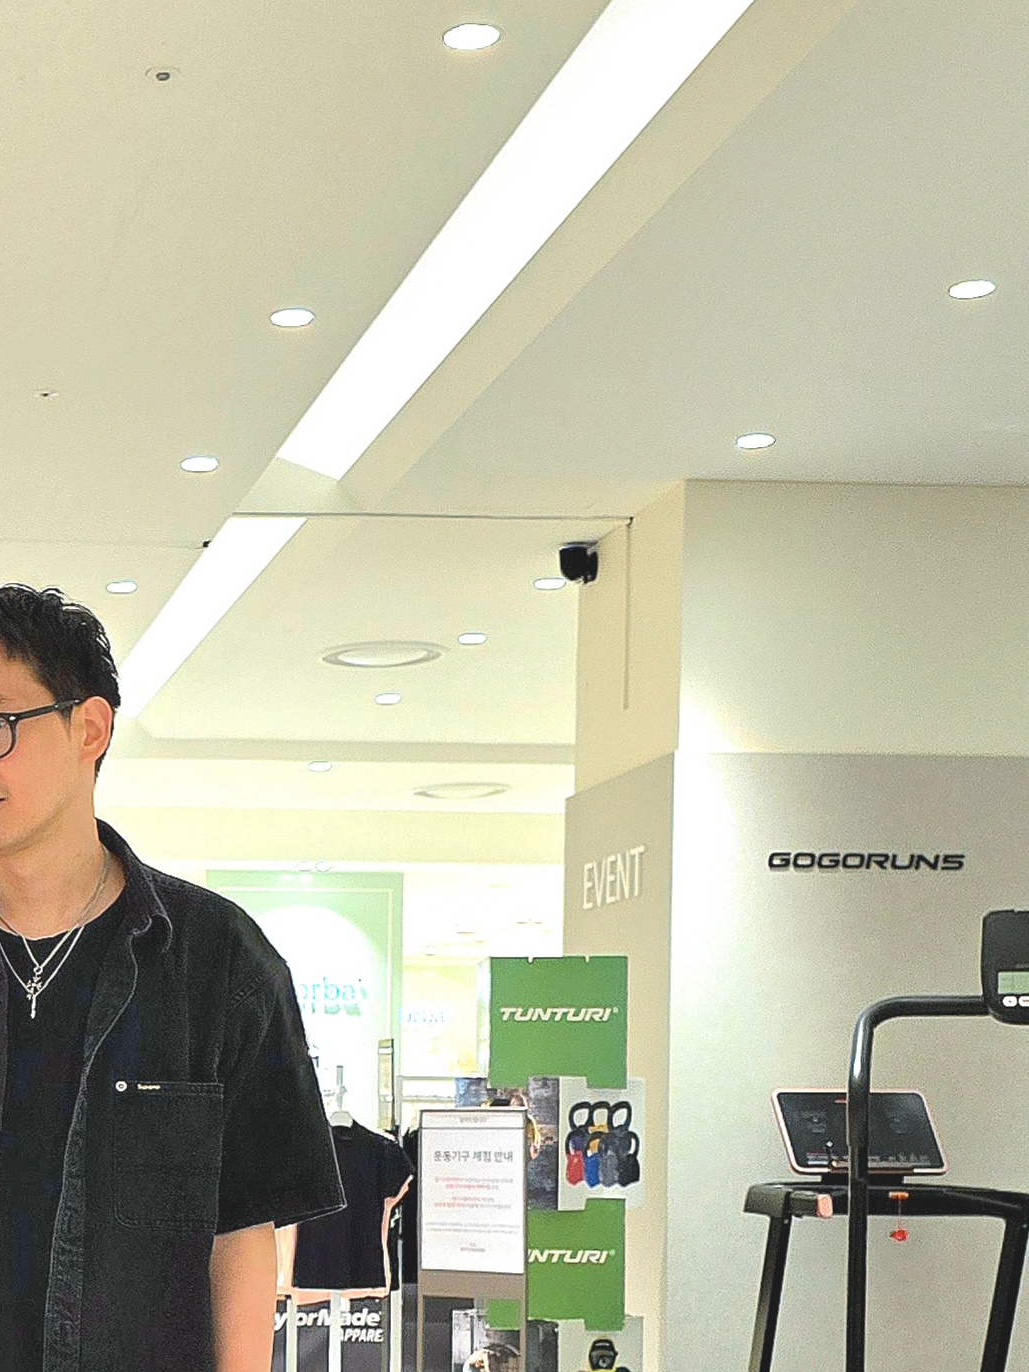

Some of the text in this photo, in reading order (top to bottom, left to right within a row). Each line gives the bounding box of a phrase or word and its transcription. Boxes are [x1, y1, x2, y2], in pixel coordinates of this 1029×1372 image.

[768, 851, 966, 871] GOGORUNS
[583, 845, 645, 910] EVENT
[500, 1007, 613, 1022] TUNTURI
[528, 1249, 609, 1263] NTURI
